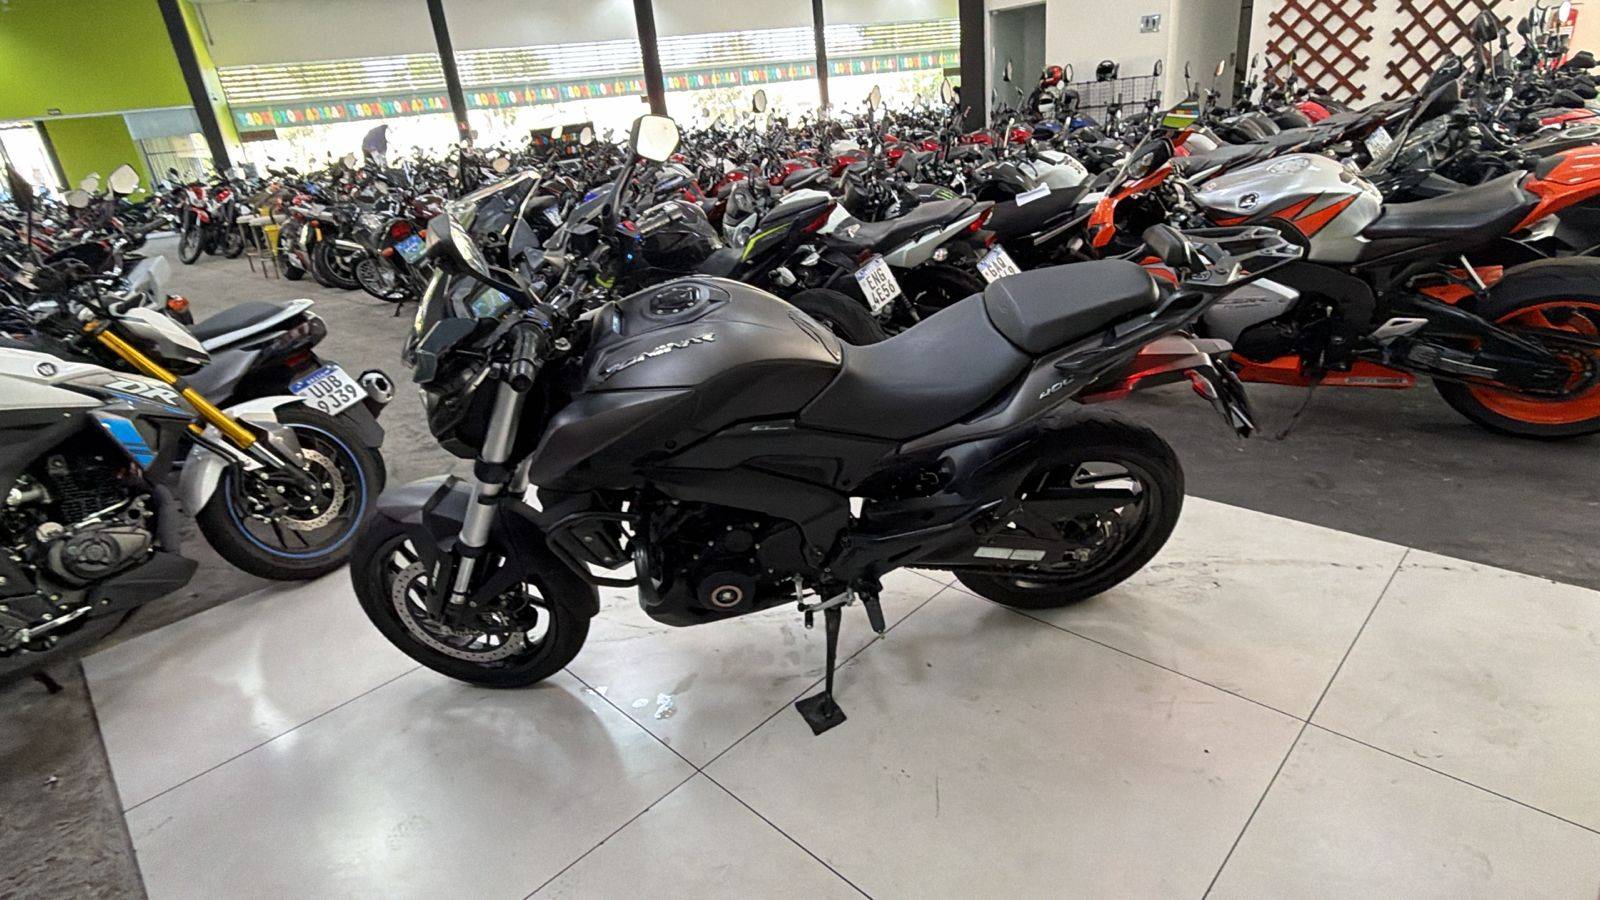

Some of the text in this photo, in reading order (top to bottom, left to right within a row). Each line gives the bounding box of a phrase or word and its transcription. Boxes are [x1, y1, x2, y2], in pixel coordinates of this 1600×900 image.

[866, 268, 886, 290] ENG
[308, 375, 342, 398] UDB
[317, 384, 358, 413] 9J39
